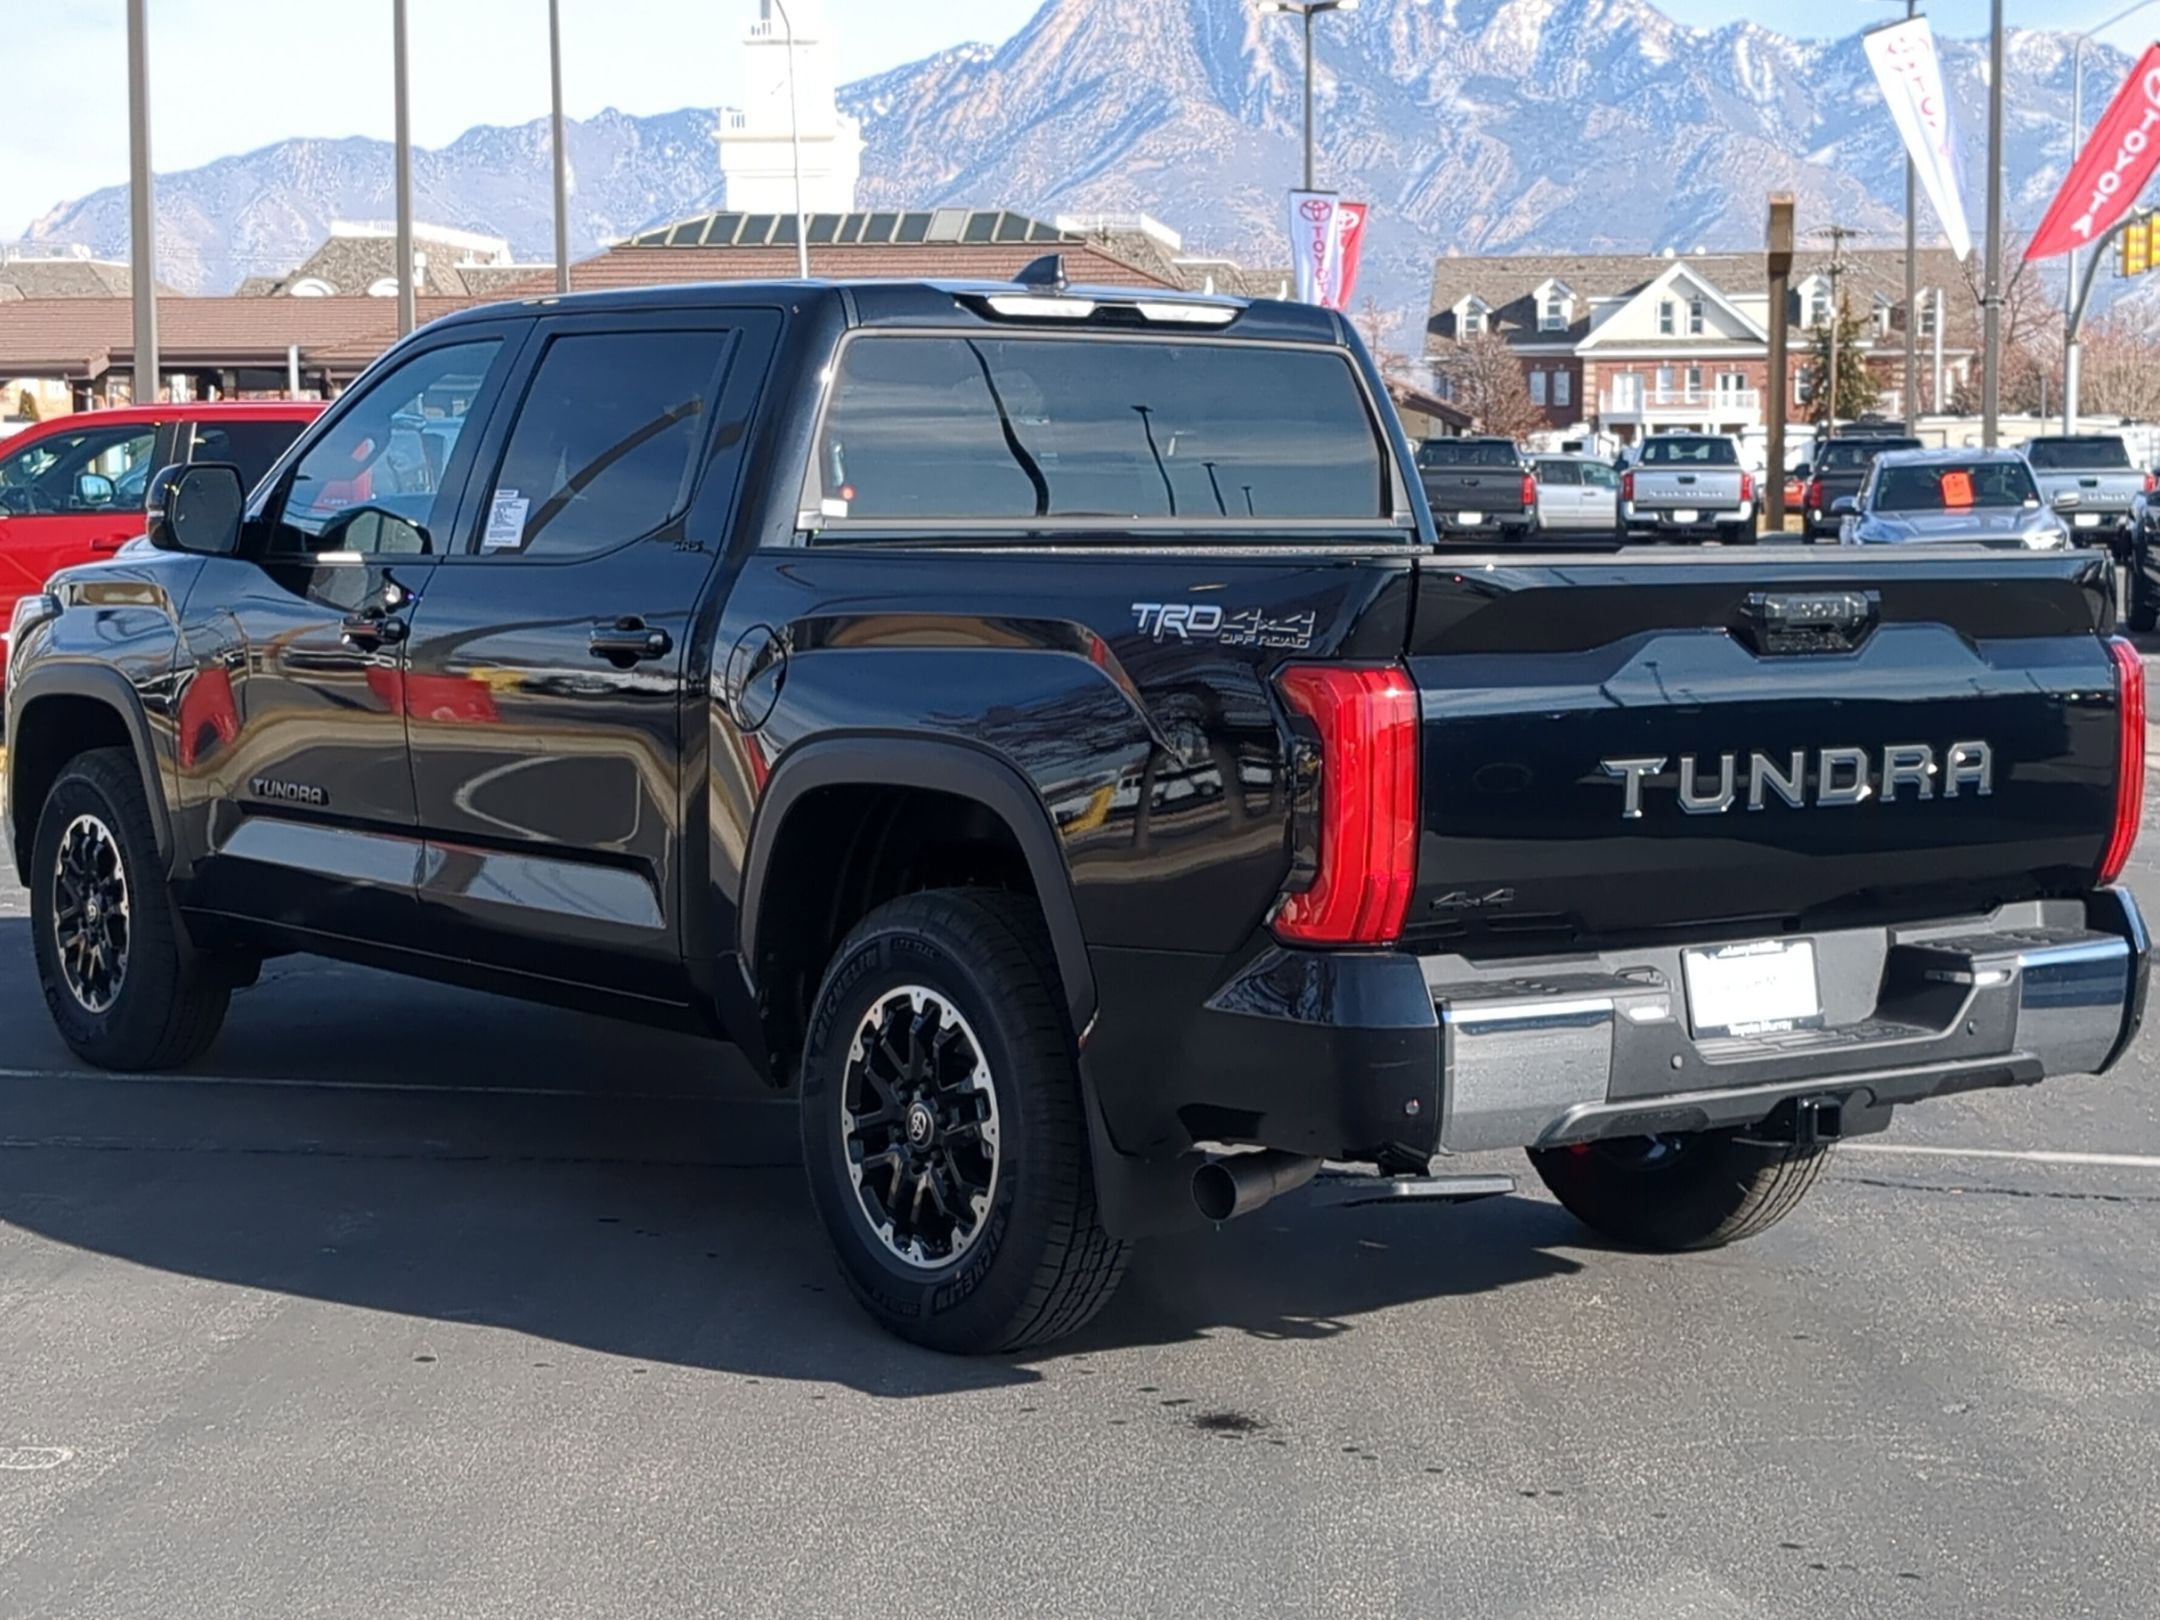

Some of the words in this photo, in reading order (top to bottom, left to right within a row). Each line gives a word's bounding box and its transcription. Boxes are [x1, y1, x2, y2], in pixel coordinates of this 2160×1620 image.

[2070, 109, 2160, 238] TOYOTA
[1312, 227, 1330, 307] TOYOTA
[1131, 603, 1224, 644] TRD
[253, 778, 323, 804] TUNDRA
[1600, 741, 1992, 819] TUNDRA
